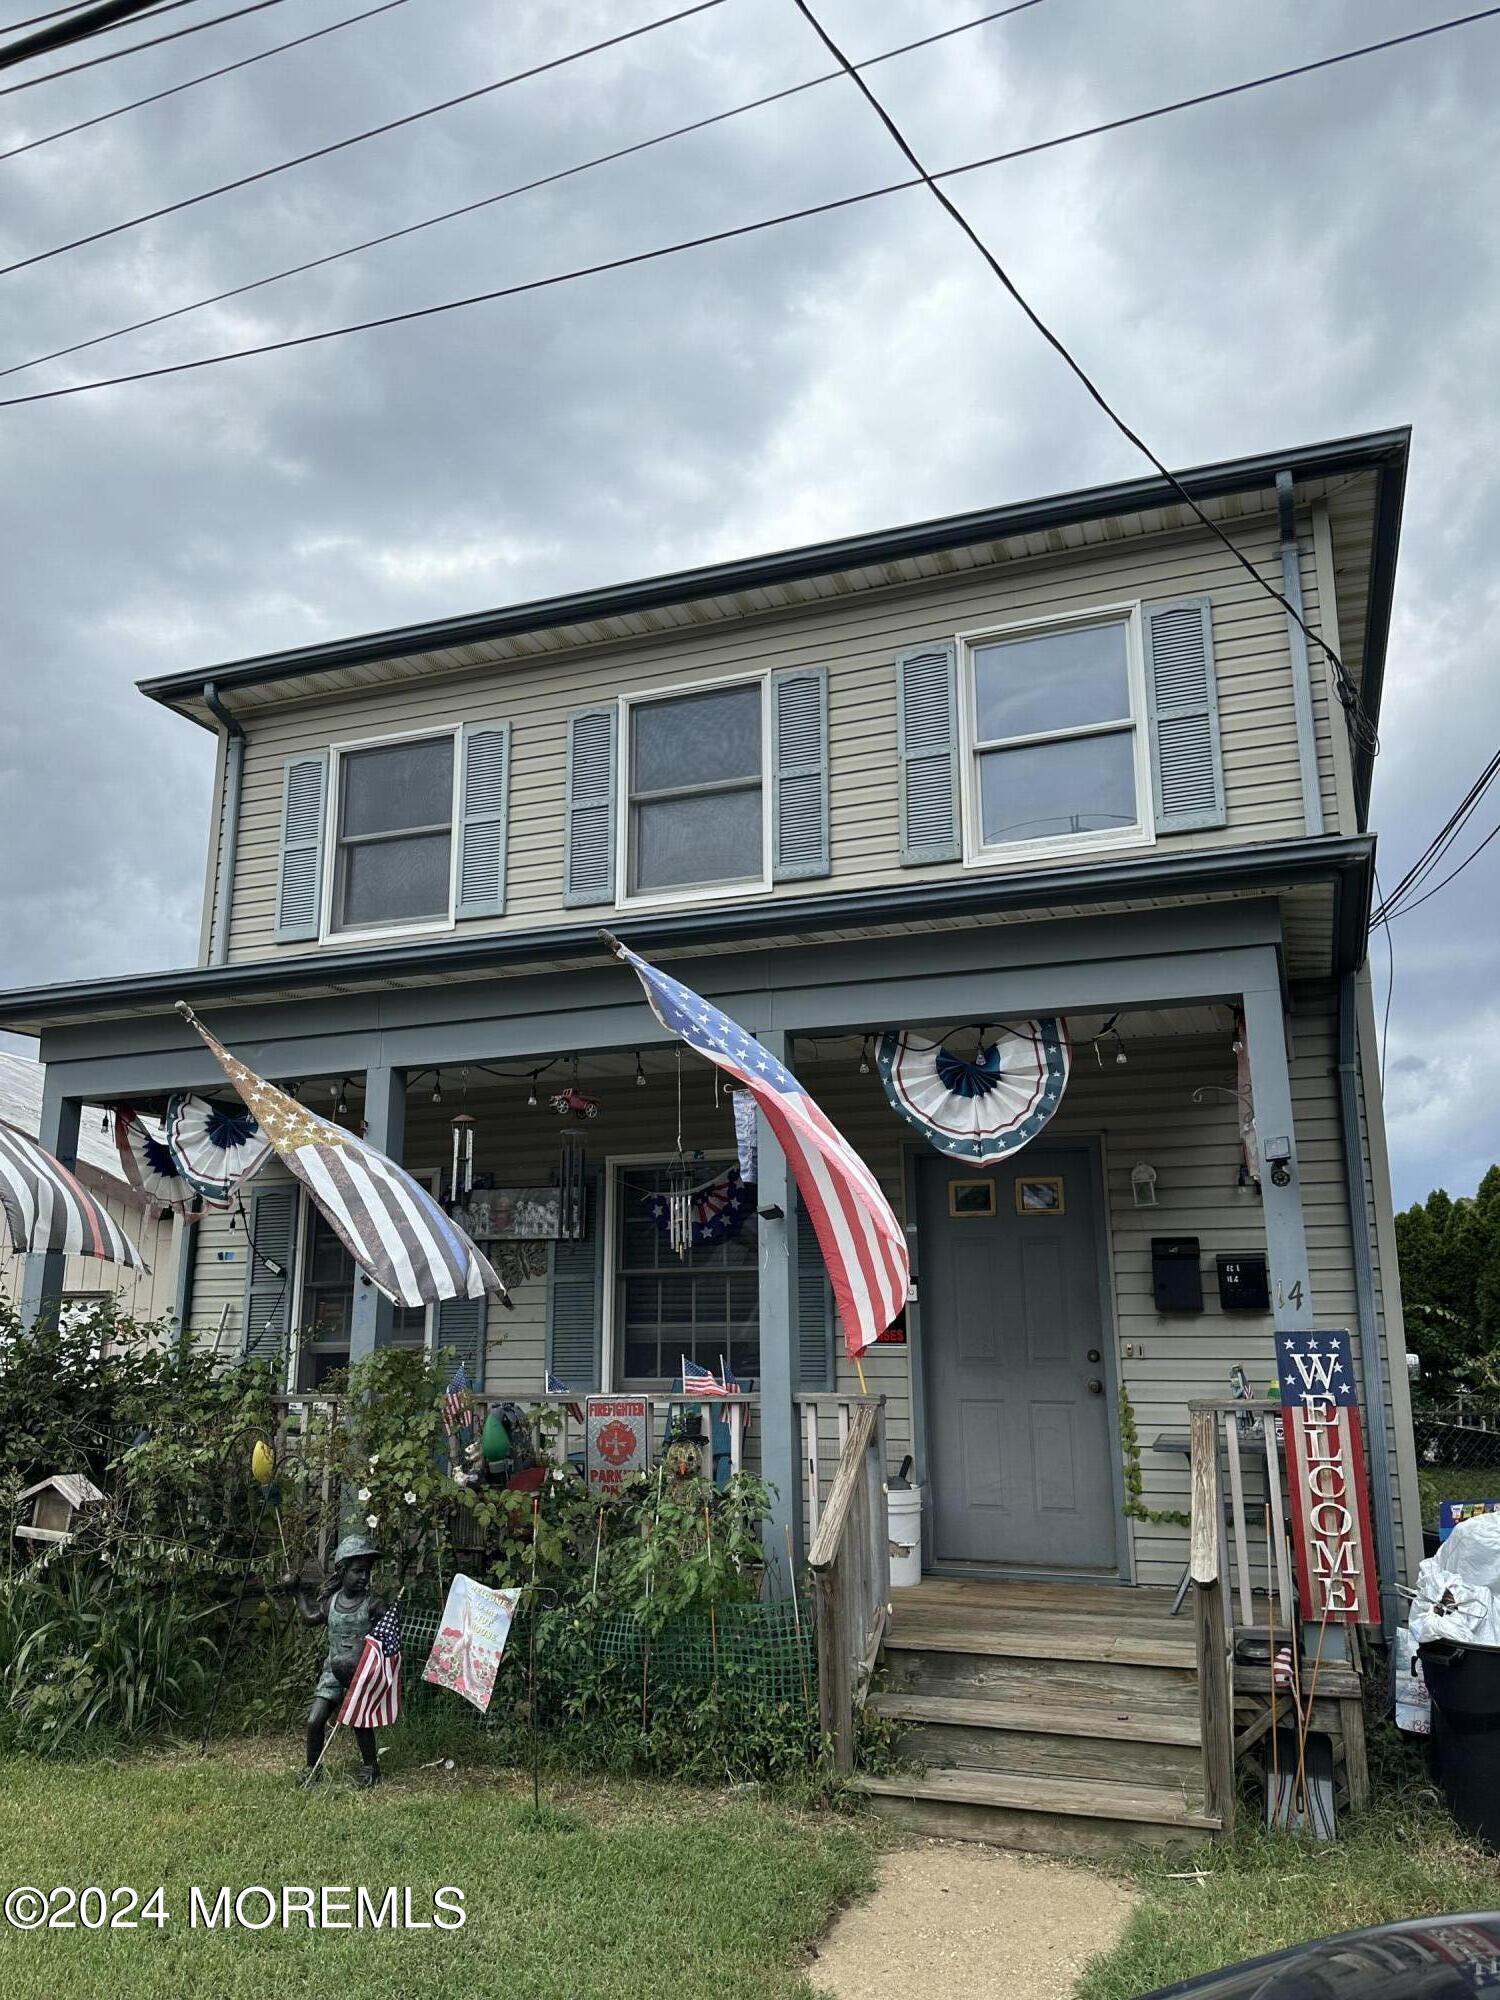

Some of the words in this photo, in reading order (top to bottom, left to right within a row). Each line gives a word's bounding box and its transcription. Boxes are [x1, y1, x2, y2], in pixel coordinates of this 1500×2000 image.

[1276, 1279, 1304, 1311] 14
[590, 1402, 645, 1417] FIREFIGHTER
[1290, 1353, 1361, 1611] WELCOME
[471, 1583, 509, 1607] WELCOME
